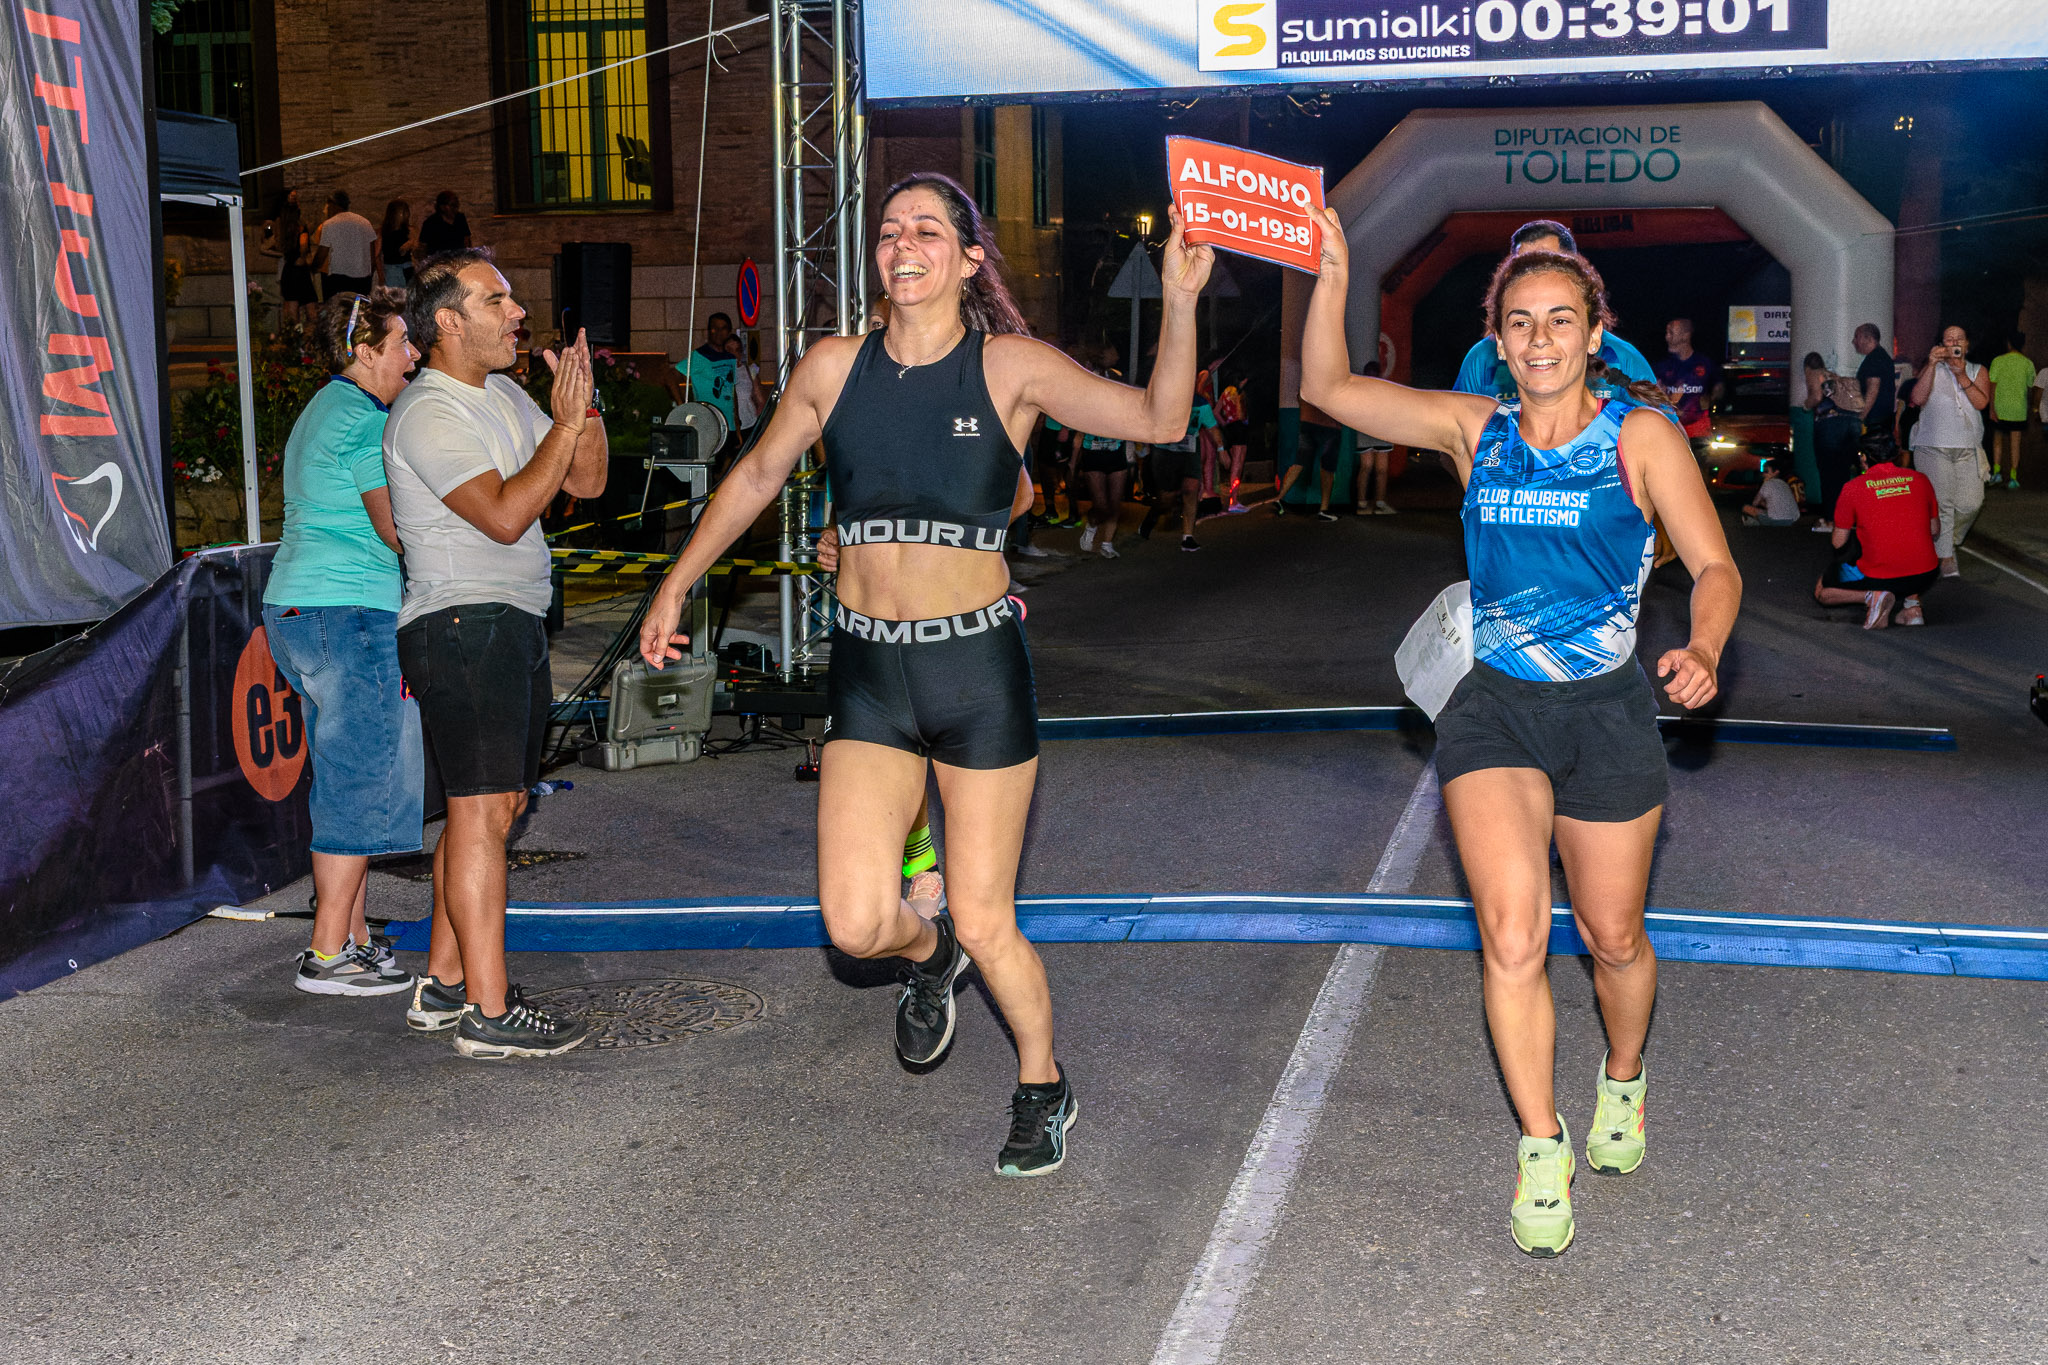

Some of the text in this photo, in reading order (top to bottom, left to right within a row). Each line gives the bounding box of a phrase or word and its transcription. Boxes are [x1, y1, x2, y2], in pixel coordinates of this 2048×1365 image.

[1281, 5, 1470, 43] sumialki
[1475, 0, 1790, 42] 00:39:01
[1281, 45, 1470, 64] ALQUILAMOS SOLUCIONES
[1495, 124, 1681, 146] DIPUTACIÓN DE
[1179, 158, 1311, 208] ALFONSO
[1495, 147, 1681, 185] TOLEDO
[1184, 202, 1310, 246] 15-01-1938
[1477, 489, 1590, 509] CLUB ONUBENSE
[1481, 506, 1580, 526] DE ATLETISMO
[246, 664, 303, 769] e3
